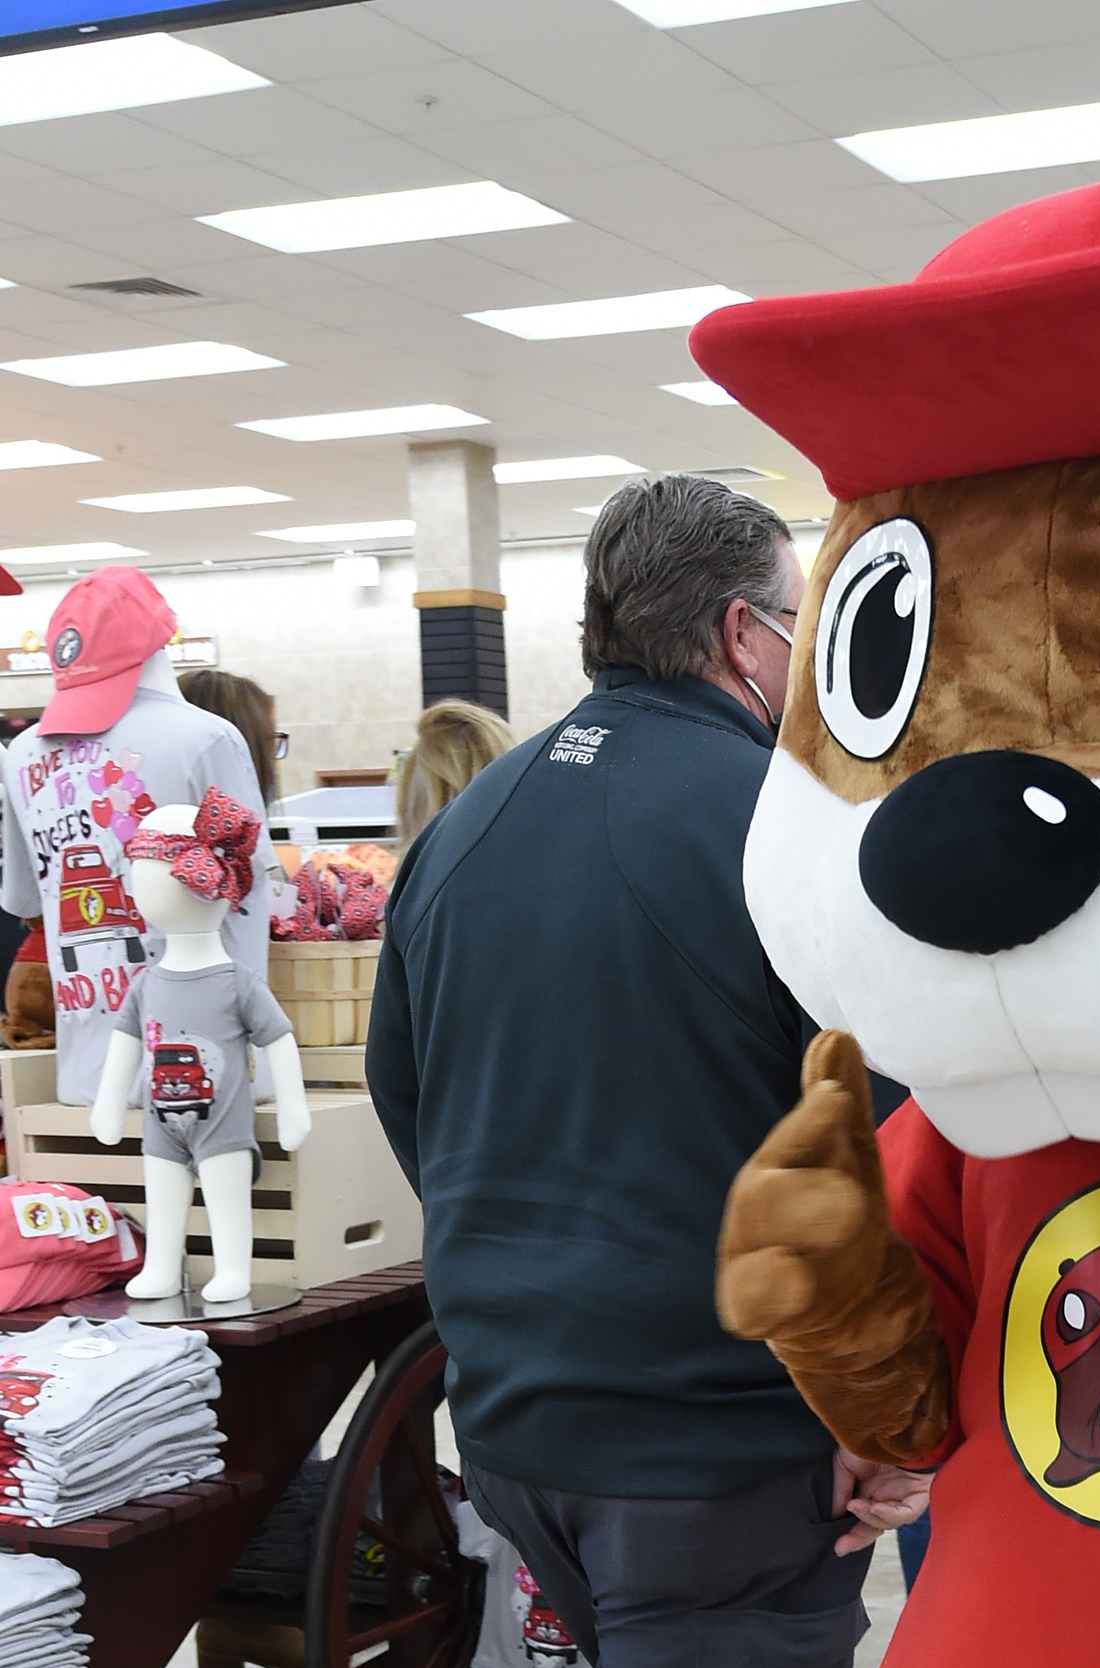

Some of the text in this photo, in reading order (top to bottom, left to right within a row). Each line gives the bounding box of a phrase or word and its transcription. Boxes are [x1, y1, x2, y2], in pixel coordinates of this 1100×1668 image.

[28, 748, 63, 797] LOVE
[66, 739, 102, 764] YOU
[549, 749, 594, 764] UNITED
[54, 771, 76, 809] TO
[56, 974, 95, 1011] AND
